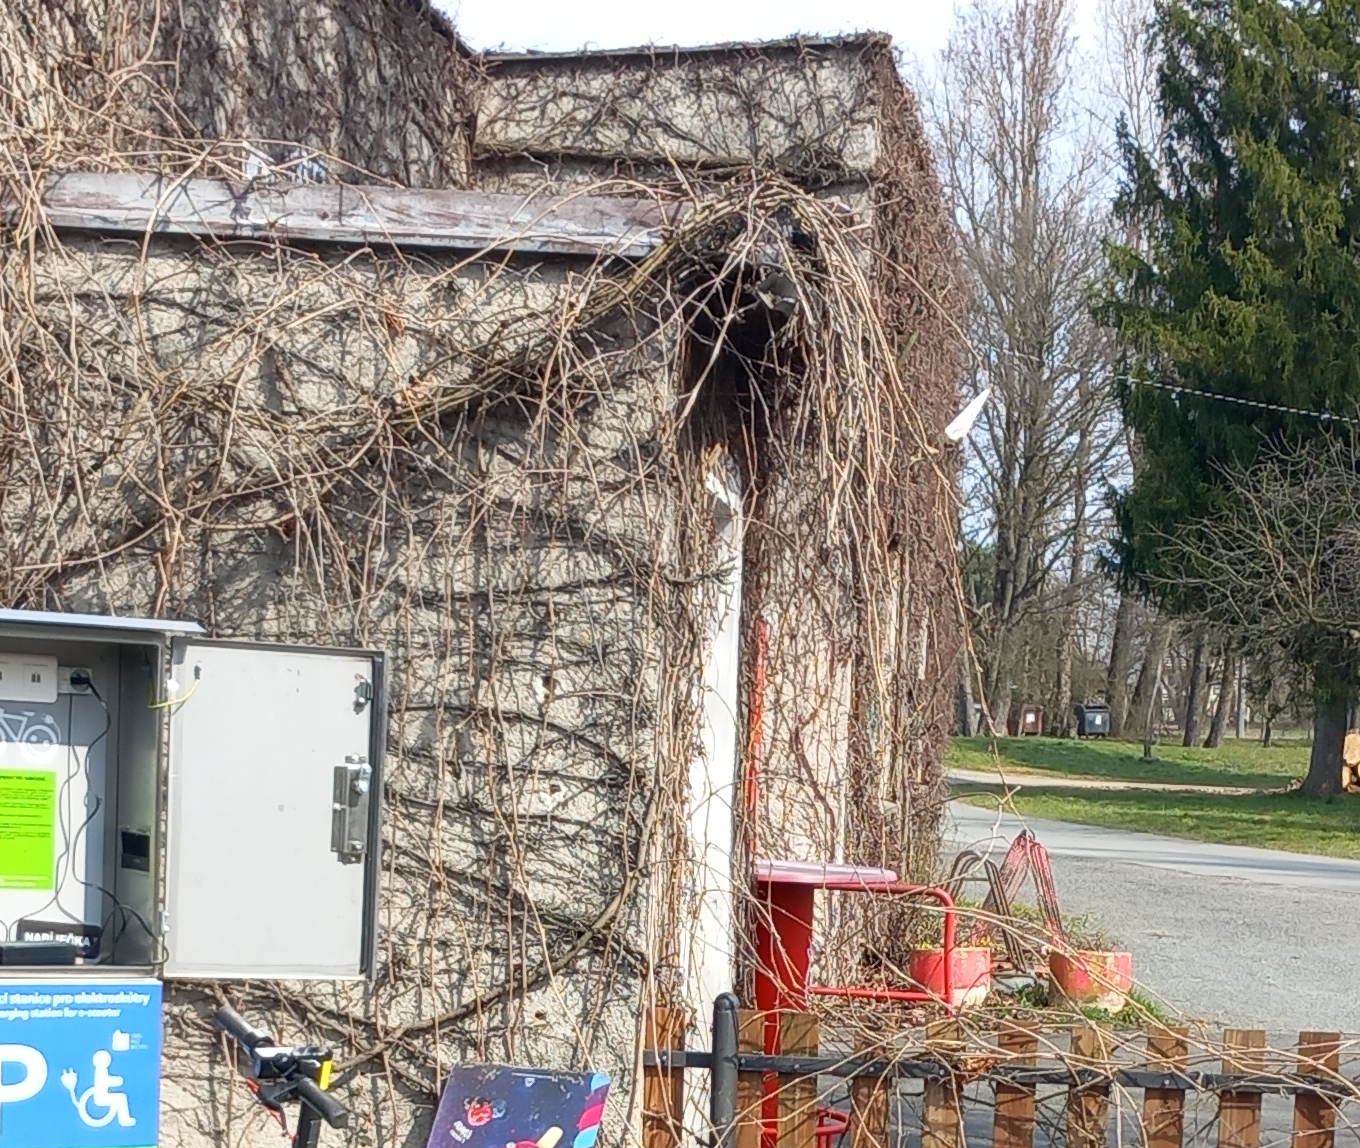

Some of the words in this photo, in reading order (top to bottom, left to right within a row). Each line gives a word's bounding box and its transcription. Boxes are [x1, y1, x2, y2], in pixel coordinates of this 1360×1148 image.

[9, 992, 51, 1005] stanice
[53, 994, 73, 1007] pro
[30, 1007, 63, 1018] station
[64, 1007, 77, 1018] for
[78, 1008, 121, 1018] e-scooter
